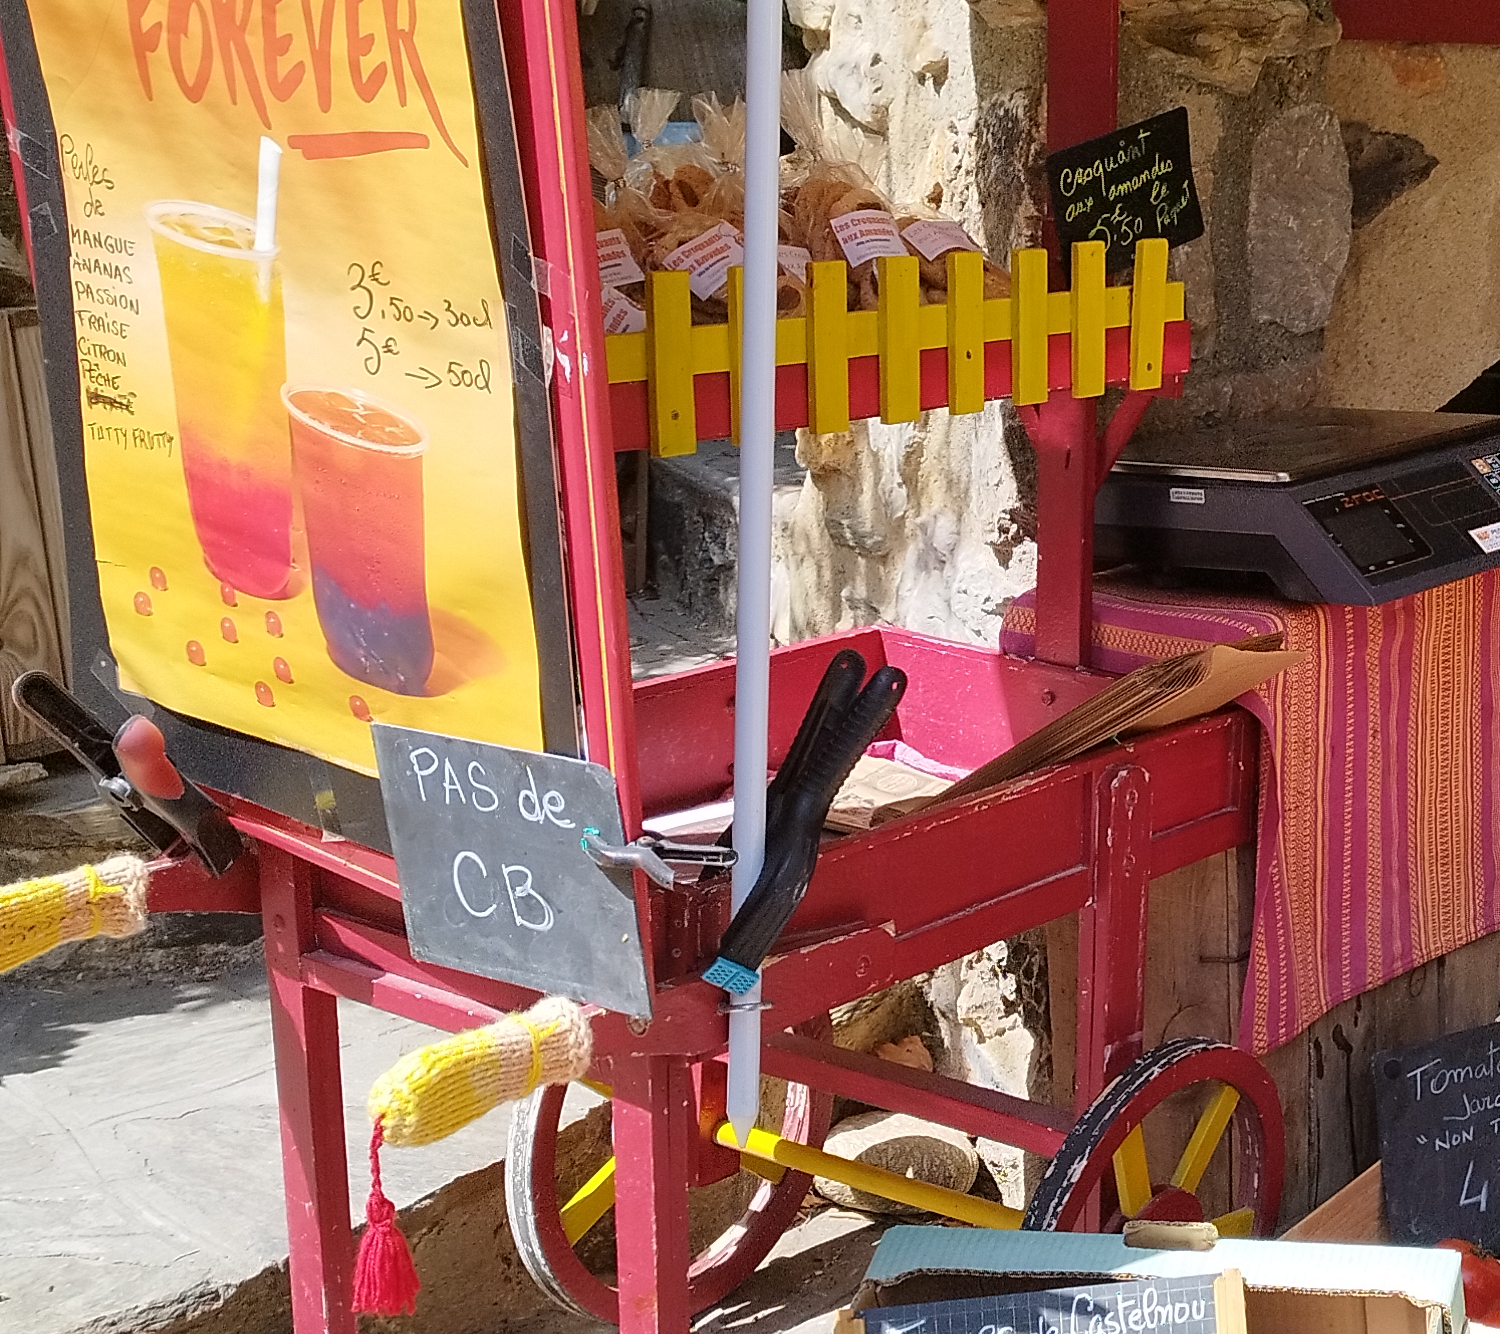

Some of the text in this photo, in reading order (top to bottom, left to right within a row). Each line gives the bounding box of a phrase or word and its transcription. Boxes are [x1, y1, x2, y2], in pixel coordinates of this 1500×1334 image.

[60, 133, 115, 190] Perles
[1108, 153, 1173, 201] amandes
[83, 187, 106, 219] de
[70, 223, 137, 257] MANGUE
[408, 747, 576, 829] PAS de
[453, 850, 554, 932] CB
